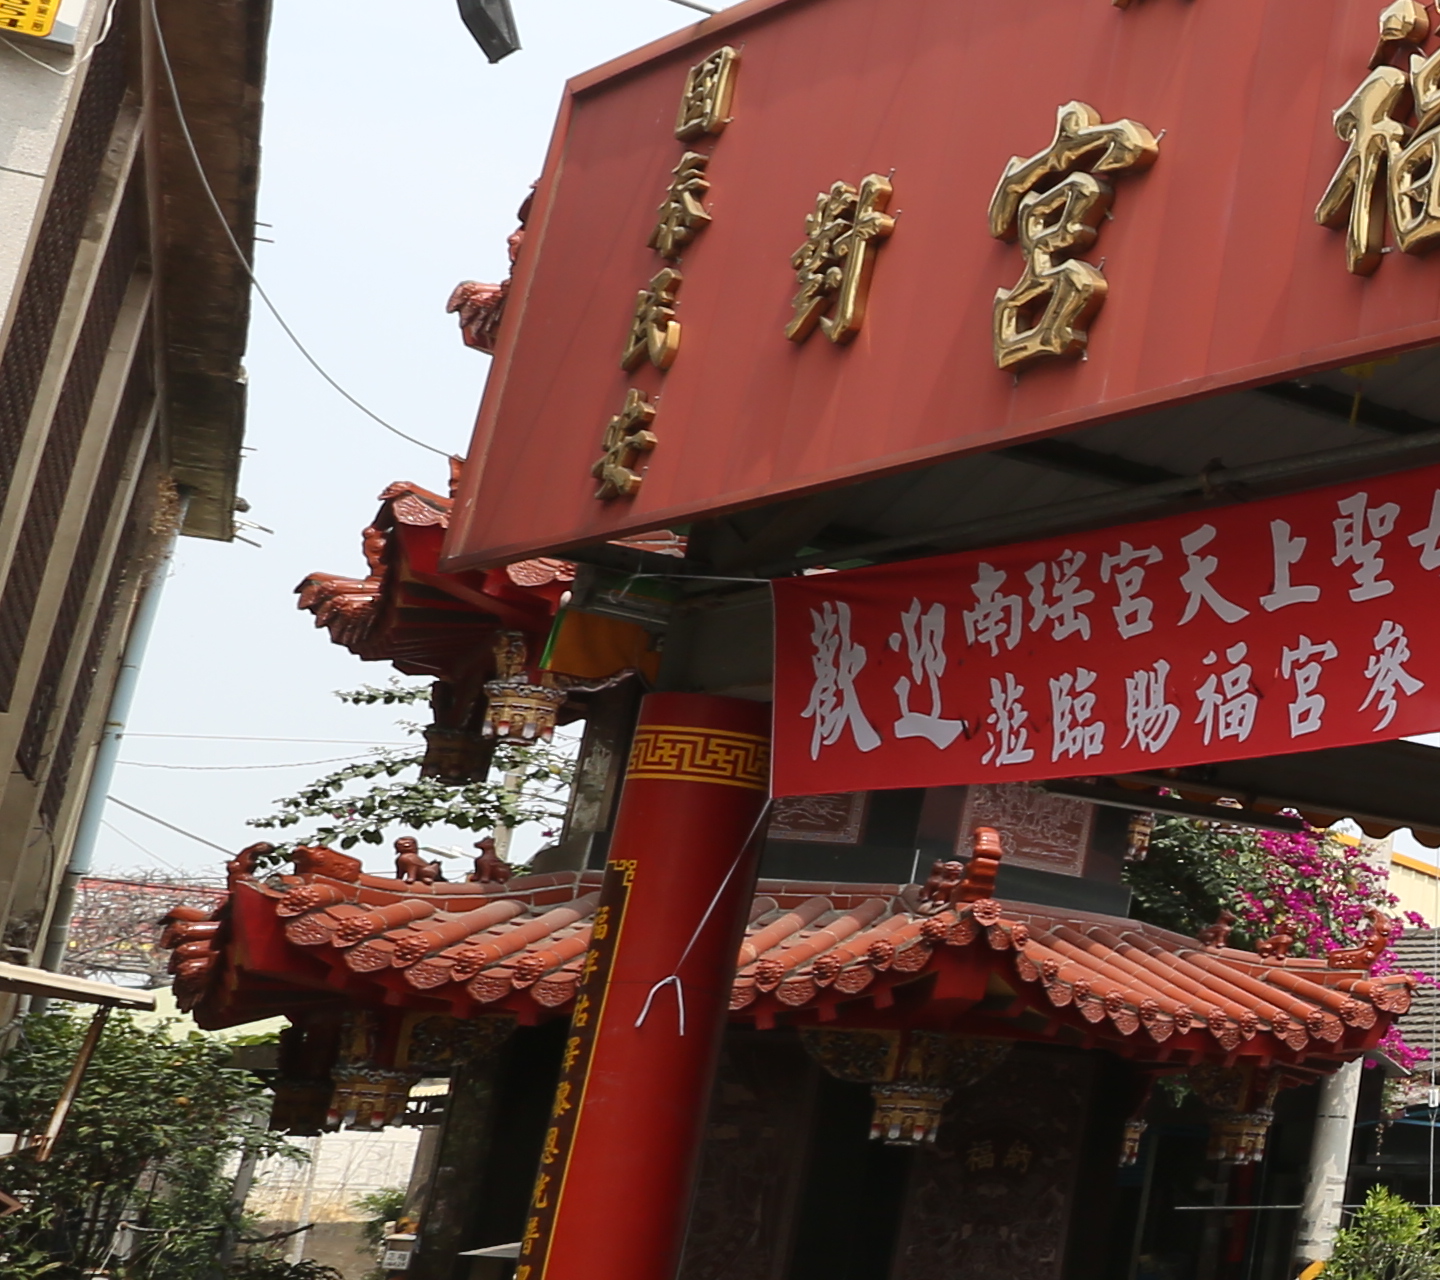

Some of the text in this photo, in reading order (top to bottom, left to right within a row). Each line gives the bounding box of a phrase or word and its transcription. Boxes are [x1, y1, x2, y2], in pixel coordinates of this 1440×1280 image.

[590, 45, 742, 501] 國泰民安
[800, 597, 967, 760] 歡迎
